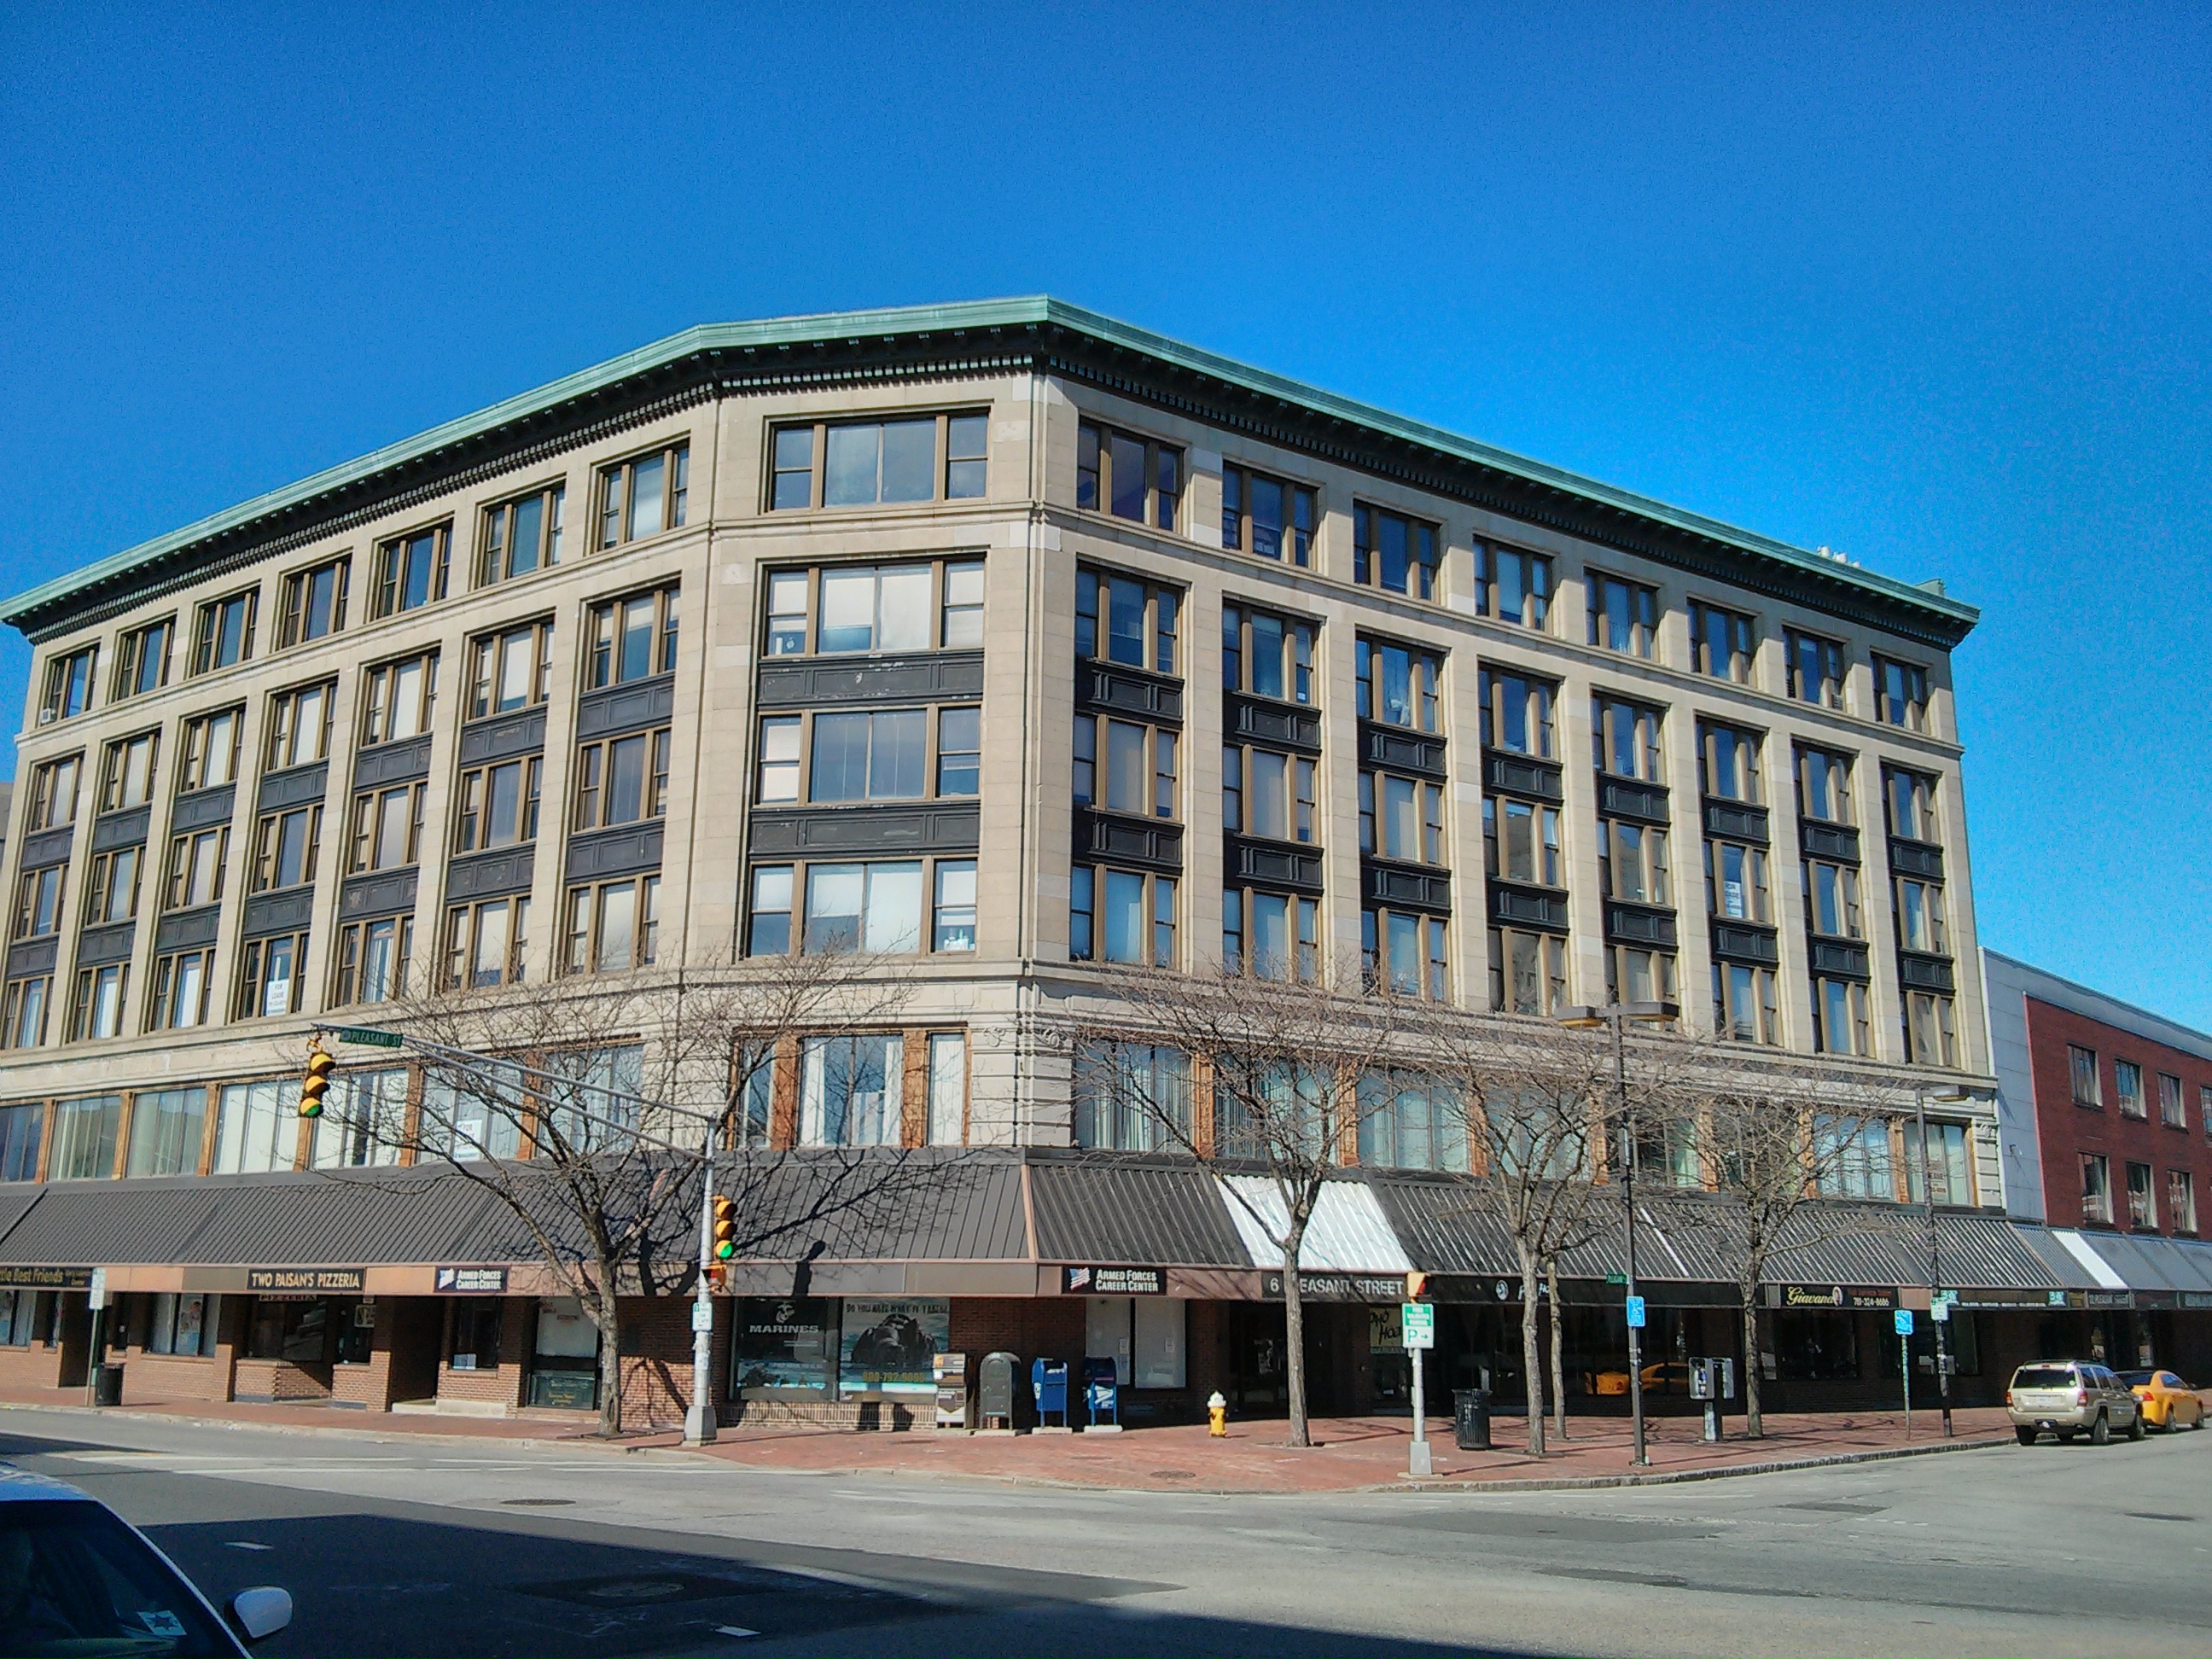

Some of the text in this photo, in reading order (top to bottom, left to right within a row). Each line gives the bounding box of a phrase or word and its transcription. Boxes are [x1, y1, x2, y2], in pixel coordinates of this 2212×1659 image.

[351, 1031, 402, 1046] PLEASANT ST
[13, 1267, 32, 1283] Best
[33, 1267, 63, 1283] Friends
[252, 1272, 360, 1288] TWO PAISAN'S PIZZERIA
[457, 1269, 502, 1280] ARMED FORCES
[1096, 1269, 1156, 1281] ARMED FORCES
[457, 1280, 502, 1289] CAREER CENTER
[1096, 1280, 1158, 1292] CAREER CENTER
[1269, 1278, 1404, 1295] 6 EASANT STREET
[749, 1324, 819, 1333] MARINES
[1407, 1329, 1417, 1342] P
